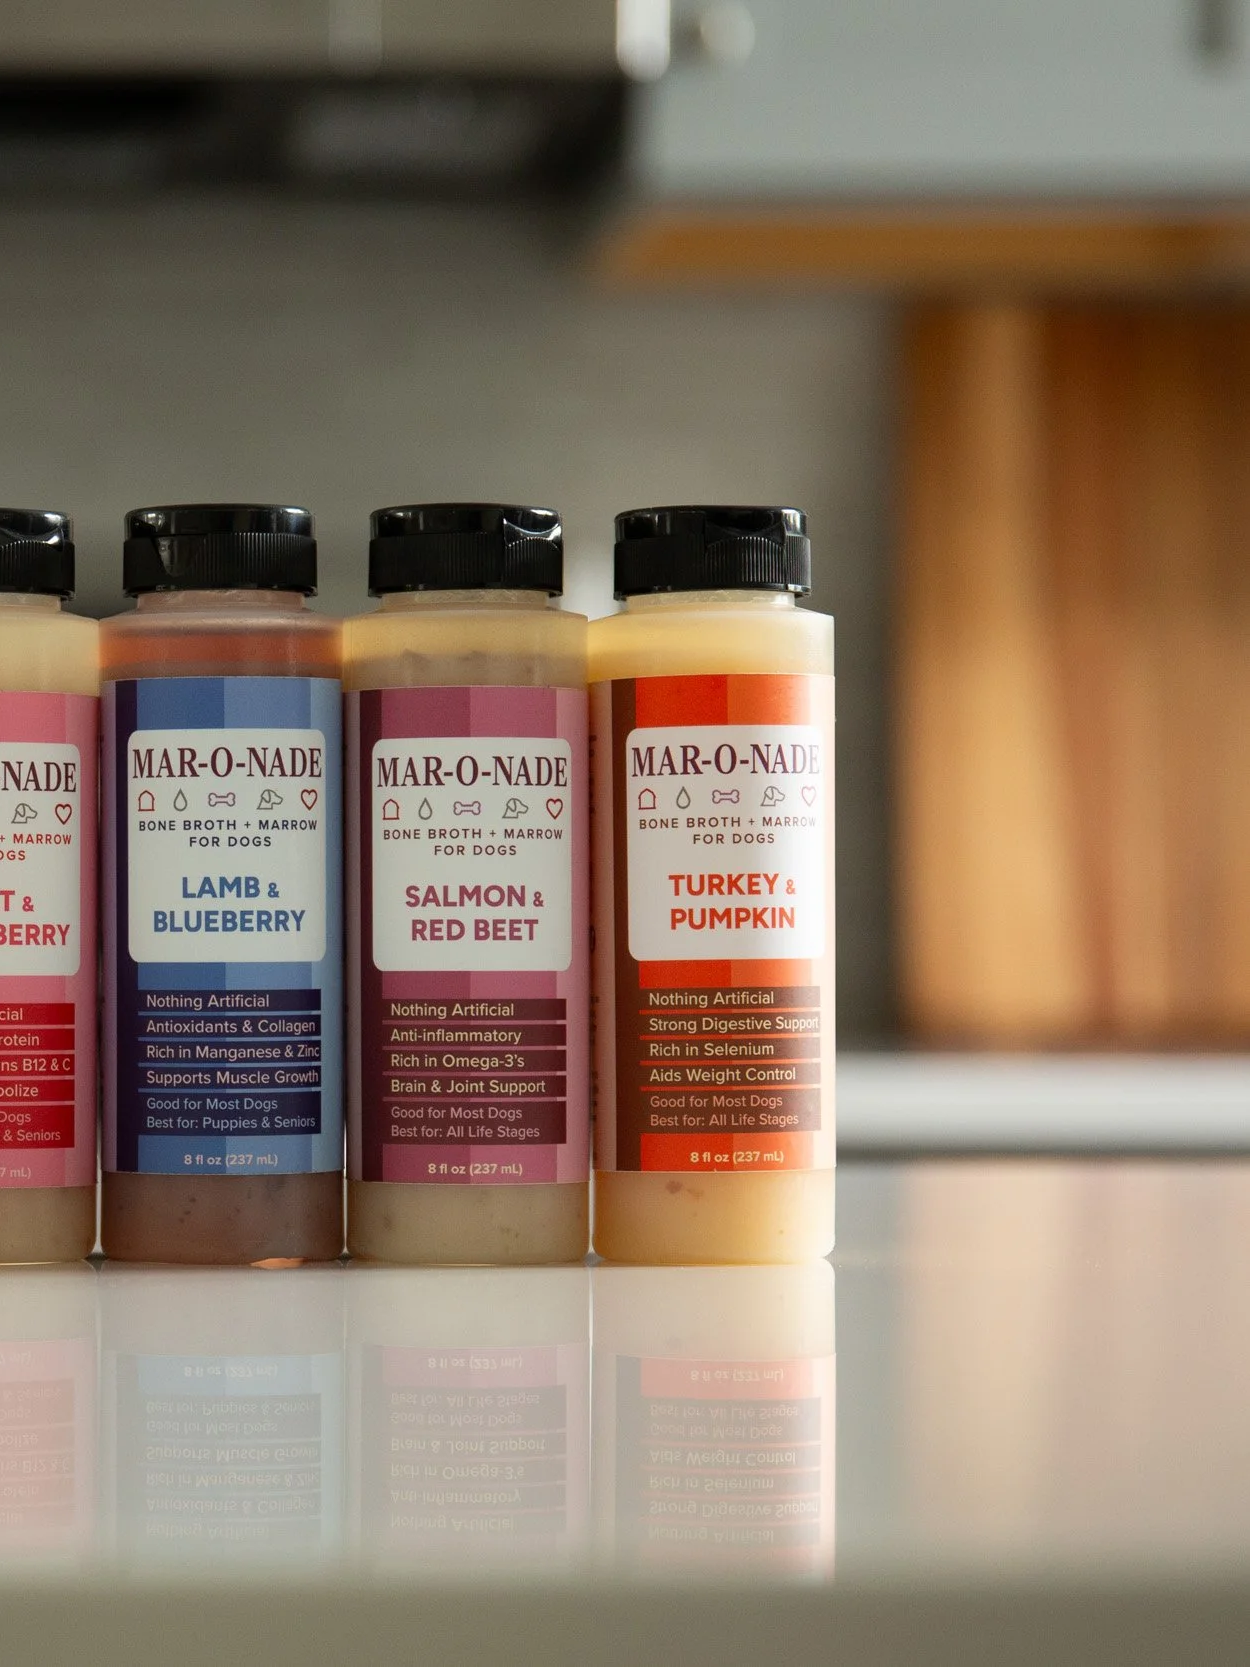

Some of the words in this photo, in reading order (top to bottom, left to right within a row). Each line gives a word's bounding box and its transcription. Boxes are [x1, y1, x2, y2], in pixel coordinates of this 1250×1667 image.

[133, 747, 321, 778] MAR-O-NADE
[632, 744, 819, 777] MAR-O-NADE
[377, 756, 567, 787] MAR-O-NADE
[640, 818, 678, 829] BONE
[687, 817, 740, 828] BROTH
[748, 818, 756, 826] +
[762, 816, 816, 827] MARROW
[13, 834, 71, 844] MARROW
[693, 834, 724, 844] FOR
[733, 833, 774, 843] DOGS
[183, 877, 260, 898] LAMB
[268, 883, 279, 898] &
[669, 873, 779, 896] TURKEY
[785, 879, 796, 895] &
[22, 896, 34, 912] &
[406, 885, 525, 907] SALMON
[533, 891, 543, 907] &
[154, 910, 305, 932] BLUEBERRY
[671, 907, 794, 930] PUMPKIN
[412, 919, 465, 941] RED
[475, 919, 538, 940] BEET
[147, 995, 202, 1010] Nothing
[208, 994, 269, 1007] Artificial
[650, 993, 708, 1008] Nothing
[713, 991, 773, 1004] Artificial
[392, 1003, 446, 1019] Nothing
[452, 1003, 513, 1016] Artificial
[147, 1020, 237, 1033] Antioxidants
[242, 1020, 252, 1033] &
[258, 1020, 315, 1035] Collagen
[650, 1018, 696, 1033] Strong
[703, 1016, 771, 1033] Digestive
[775, 1016, 819, 1033] Support
[391, 1029, 521, 1044] Anti-inflammatory
[147, 1045, 174, 1058] Rich
[179, 1046, 191, 1058] in
[196, 1046, 281, 1061] Manganese
[285, 1045, 293, 1057] &
[298, 1045, 319, 1057] Zinc
[650, 1044, 680, 1056] Rich
[686, 1043, 698, 1056] in
[704, 1042, 774, 1056] Selenium
[23, 1058, 46, 1071] B12
[51, 1058, 59, 1071] &
[63, 1058, 70, 1070] C
[392, 1054, 419, 1067] Rich
[425, 1054, 437, 1067] in
[147, 1071, 211, 1086] Supports
[217, 1071, 270, 1084] Muscle
[275, 1070, 318, 1083] Growth
[650, 1069, 681, 1081] Aids
[686, 1069, 741, 1084] Weight
[746, 1068, 795, 1081] Control
[392, 1080, 425, 1092] Brain
[431, 1080, 441, 1093] &
[447, 1080, 485, 1093] Joint
[490, 1080, 545, 1095] Support
[147, 1116, 173, 1128] Best
[177, 1117, 198, 1128] for:
[203, 1117, 257, 1131] Puppies
[261, 1116, 270, 1128] &
[275, 1116, 315, 1128] Seniors
